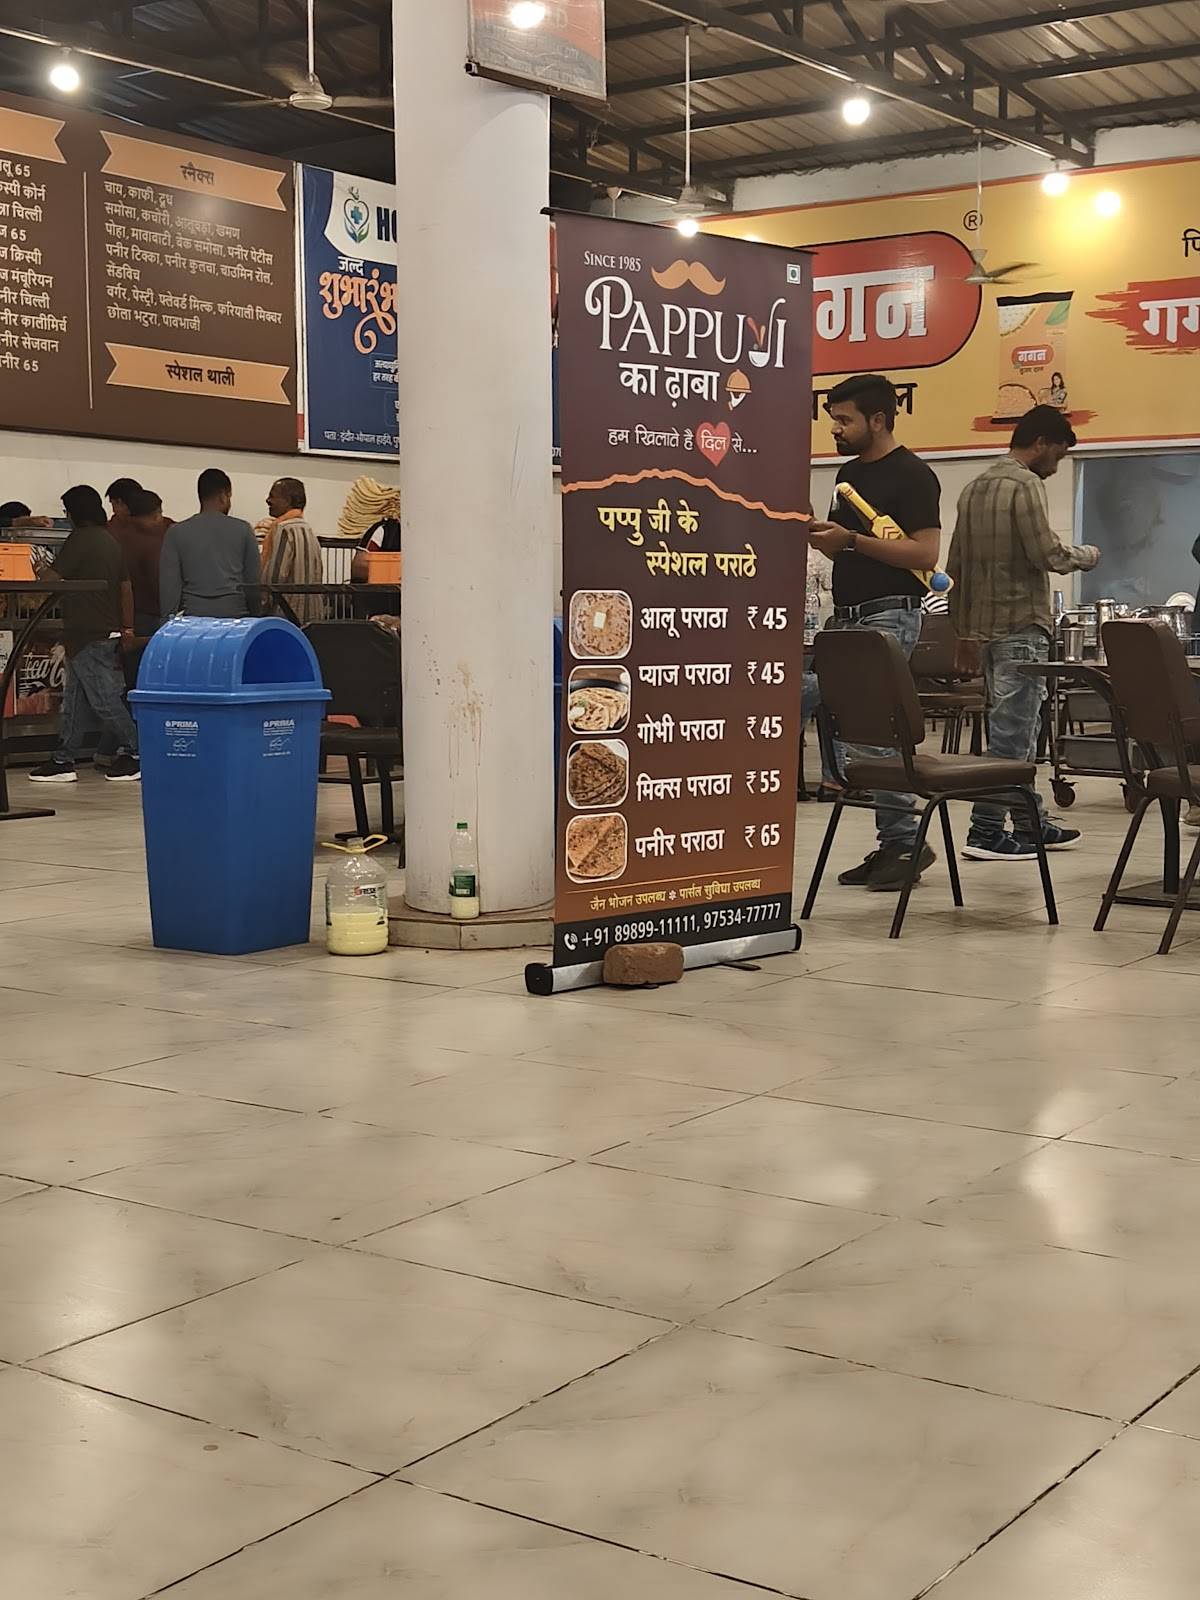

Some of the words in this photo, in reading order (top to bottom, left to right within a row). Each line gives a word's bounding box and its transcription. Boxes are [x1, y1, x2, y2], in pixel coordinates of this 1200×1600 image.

[15, 164, 30, 177] 65
[23, 182, 46, 201] कोर्न
[12, 201, 42, 222] चिल्ली
[11, 228, 26, 241] 65
[10, 244, 42, 265] क्रिस्पी
[105, 242, 129, 259] पनीर
[164, 252, 188, 269] पनीर
[227, 244, 249, 261] पनीर
[618, 255, 641, 272] 1985
[338, 255, 364, 275] जल्द
[11, 267, 54, 288] मंचूरियन
[0, 286, 18, 304] नीर
[20, 288, 50, 309] चिल्ली
[813, 264, 935, 343] गन
[0, 308, 19, 326] नीर
[20, 312, 67, 332] कालीमिर्च
[107, 302, 132, 321] छोला
[162, 315, 200, 332] पावभाजी
[0, 330, 19, 348] नीर
[21, 332, 60, 352] सेजवान
[23, 359, 39, 372] 65
[165, 360, 203, 382] स्पेशल
[207, 365, 235, 386] थाली
[619, 362, 659, 397] का
[608, 428, 629, 446] हम
[635, 424, 680, 448] खिलाते
[701, 433, 728, 451] दिल
[648, 498, 672, 535] जी
[676, 499, 700, 535] के
[645, 541, 709, 577] स्पेशल
[714, 543, 758, 578] पराठे
[640, 607, 681, 638] आलू
[681, 607, 728, 630] पराठा
[762, 607, 788, 630] 45
[638, 664, 680, 686] प्याज
[684, 663, 732, 686] पराठा
[760, 661, 785, 685] 45
[171, 720, 199, 729] PRIMA
[637, 713, 675, 744] गोभी
[679, 719, 726, 742] पराठा
[760, 716, 783, 739] 45
[636, 772, 682, 802] मिक्स
[687, 774, 732, 798] पराठा
[760, 769, 781, 793] 55
[635, 827, 676, 858] पनीर
[681, 829, 726, 853] पराठा
[760, 823, 780, 847] 65
[590, 895, 606, 911] जैन
[608, 892, 633, 909] भोजन
[582, 926, 609, 949] +91
[614, 914, 701, 943] 89899-11111,
[703, 902, 782, 930] 97534-77777
